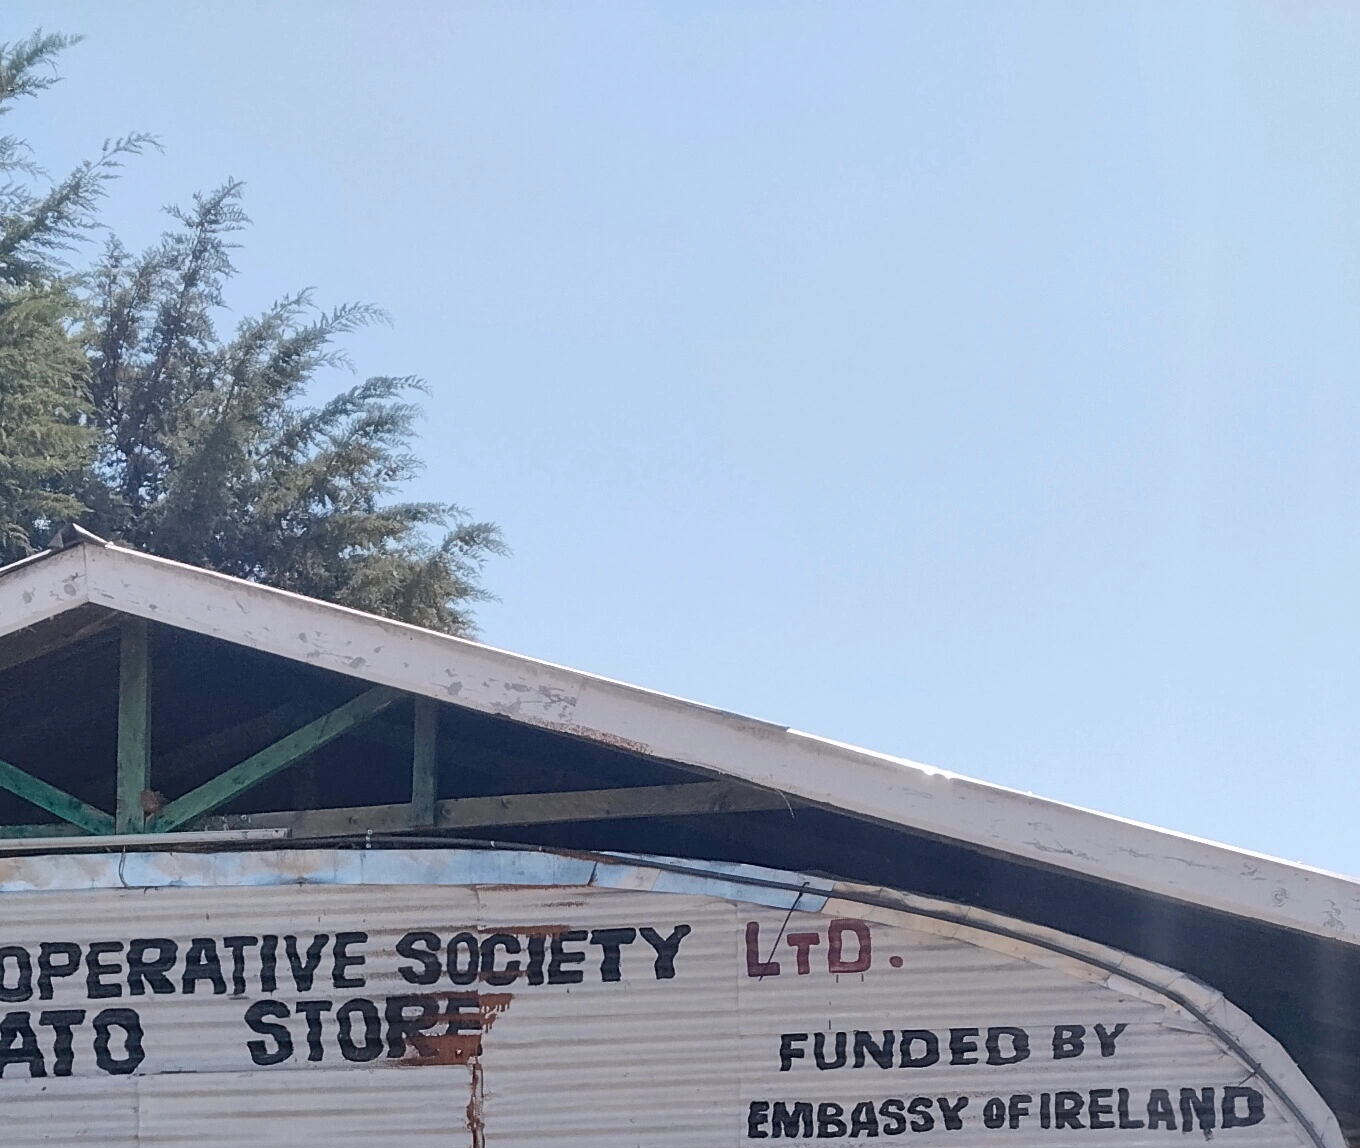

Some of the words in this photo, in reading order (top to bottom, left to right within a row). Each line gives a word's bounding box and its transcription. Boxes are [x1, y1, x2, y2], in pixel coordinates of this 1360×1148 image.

[395, 924, 691, 986] SOCIETY
[745, 919, 903, 978] LTD.
[245, 998, 484, 1066] STORE
[778, 1026, 1031, 1072] FUNDED
[1052, 1022, 1127, 1059] BY
[747, 1096, 970, 1139] EMBASSY
